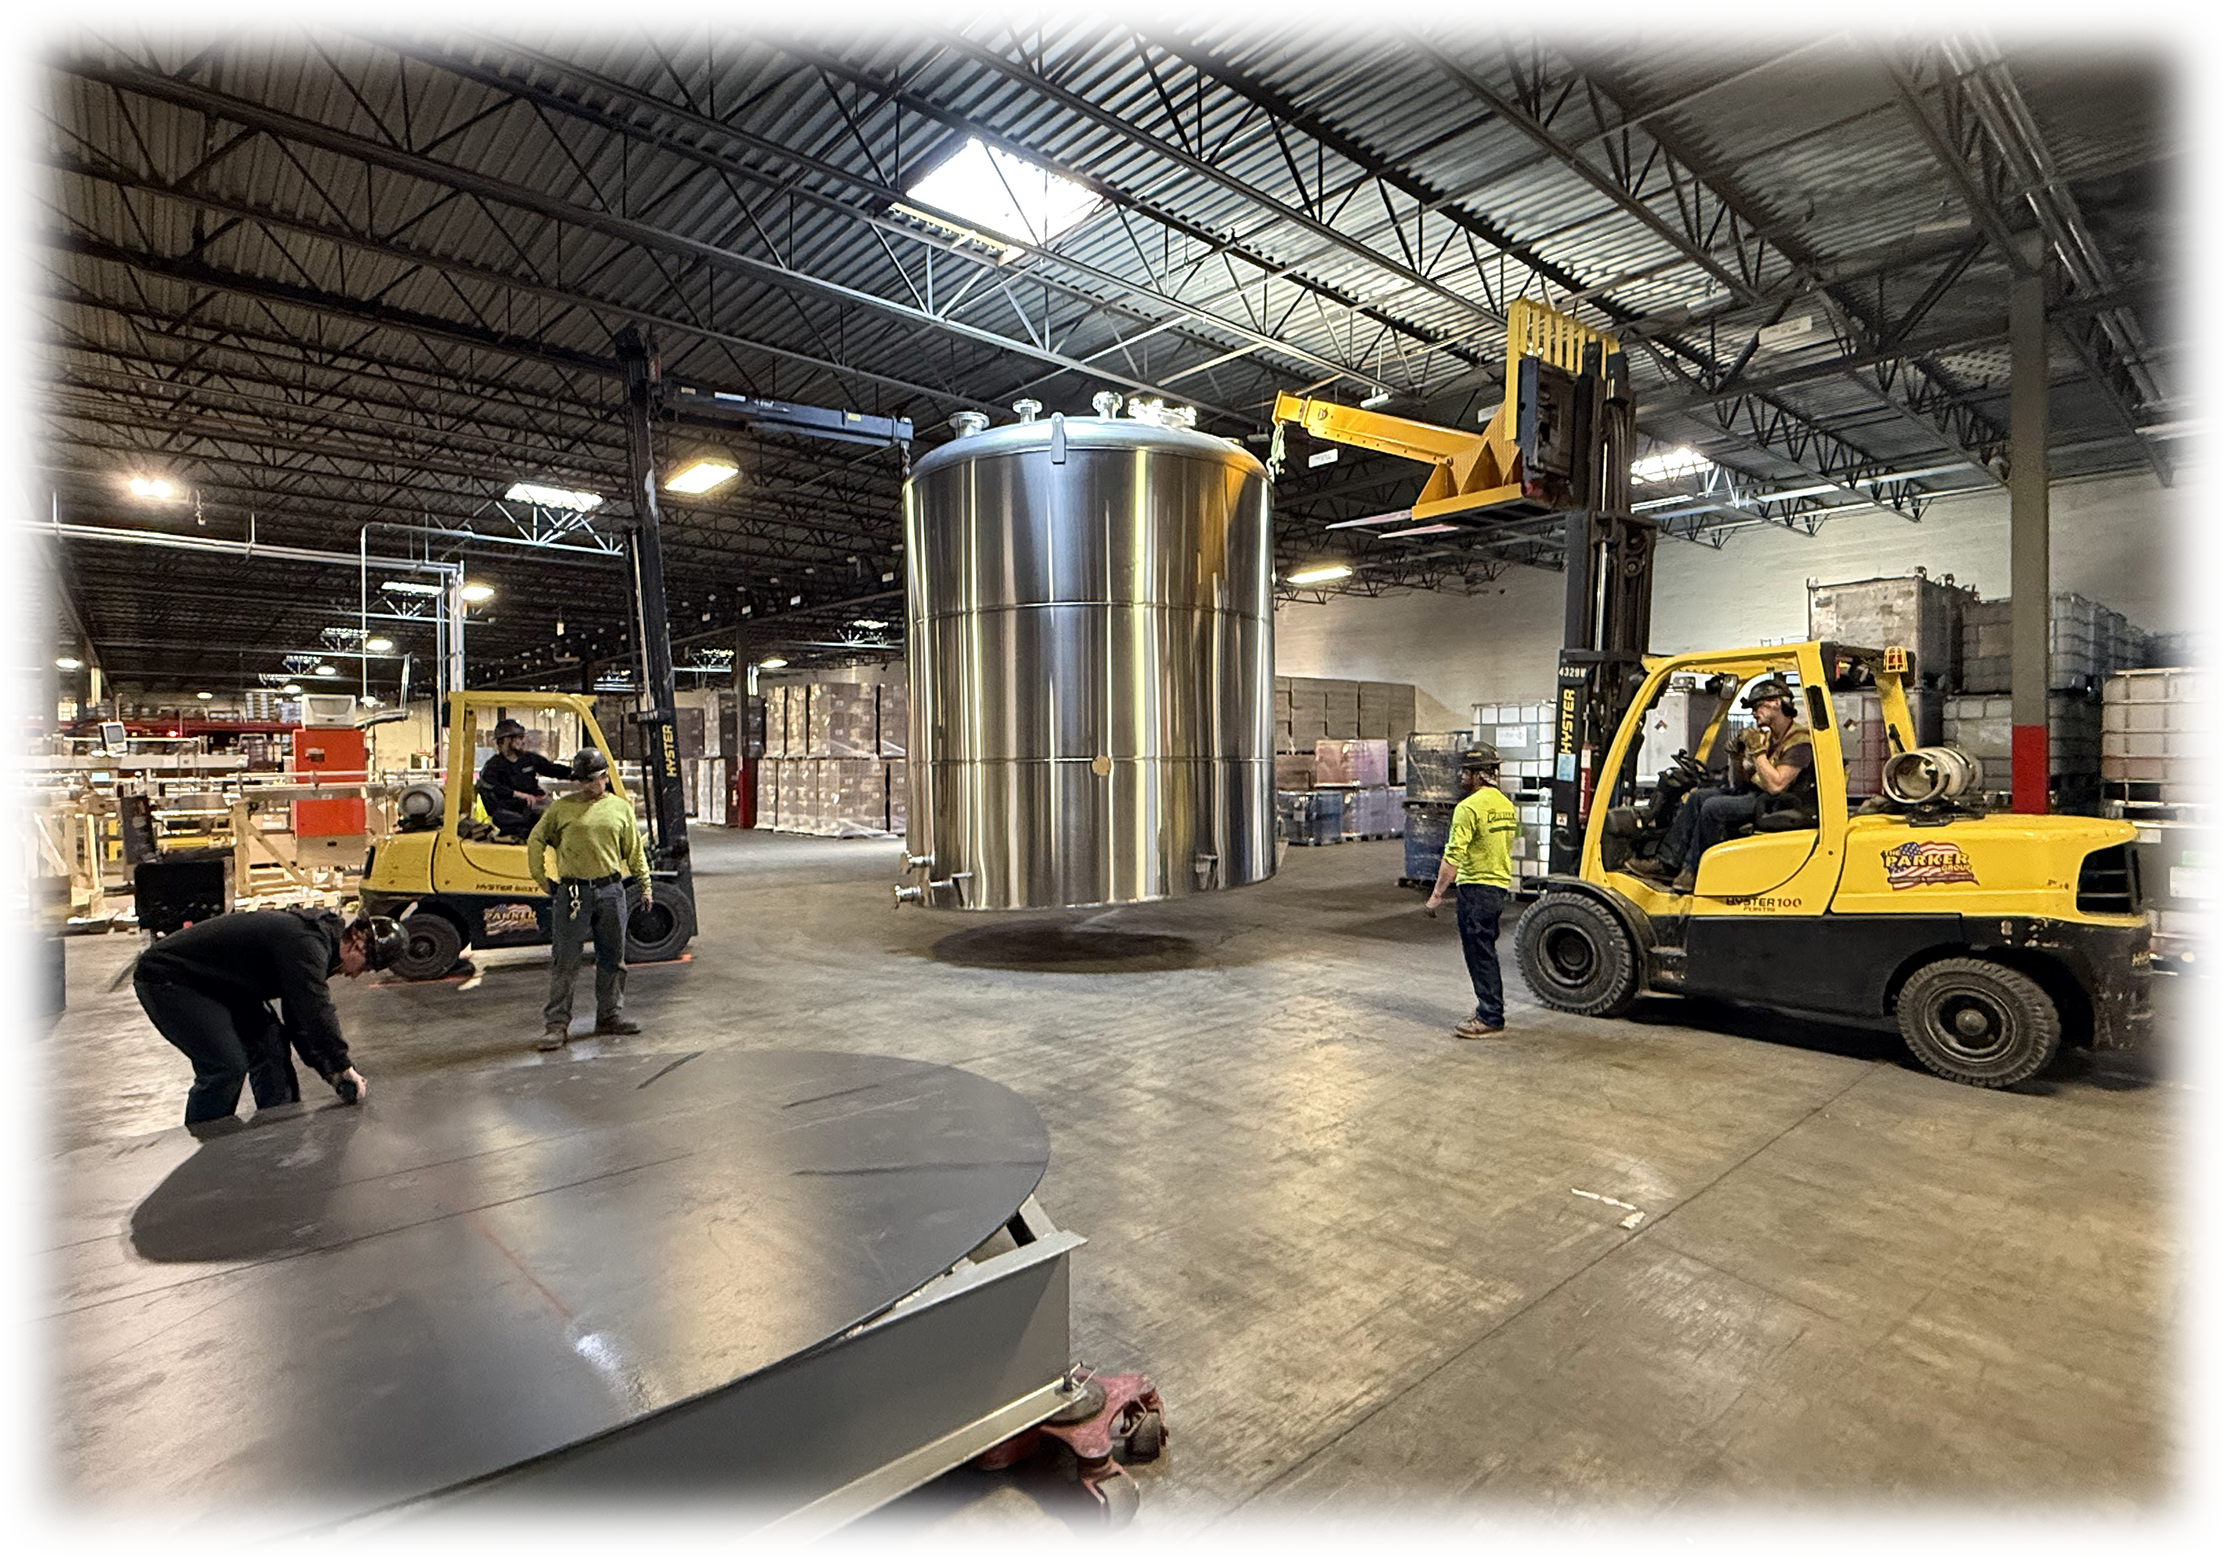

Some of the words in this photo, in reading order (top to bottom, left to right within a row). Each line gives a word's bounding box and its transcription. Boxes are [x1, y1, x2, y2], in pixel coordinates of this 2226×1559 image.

[1560, 689, 1576, 754] HYSTER
[662, 724, 677, 777] HYSTER
[1885, 853, 1969, 868] PARKER
[1726, 896, 1775, 908] HYSTER
[1777, 897, 1803, 908] 100
